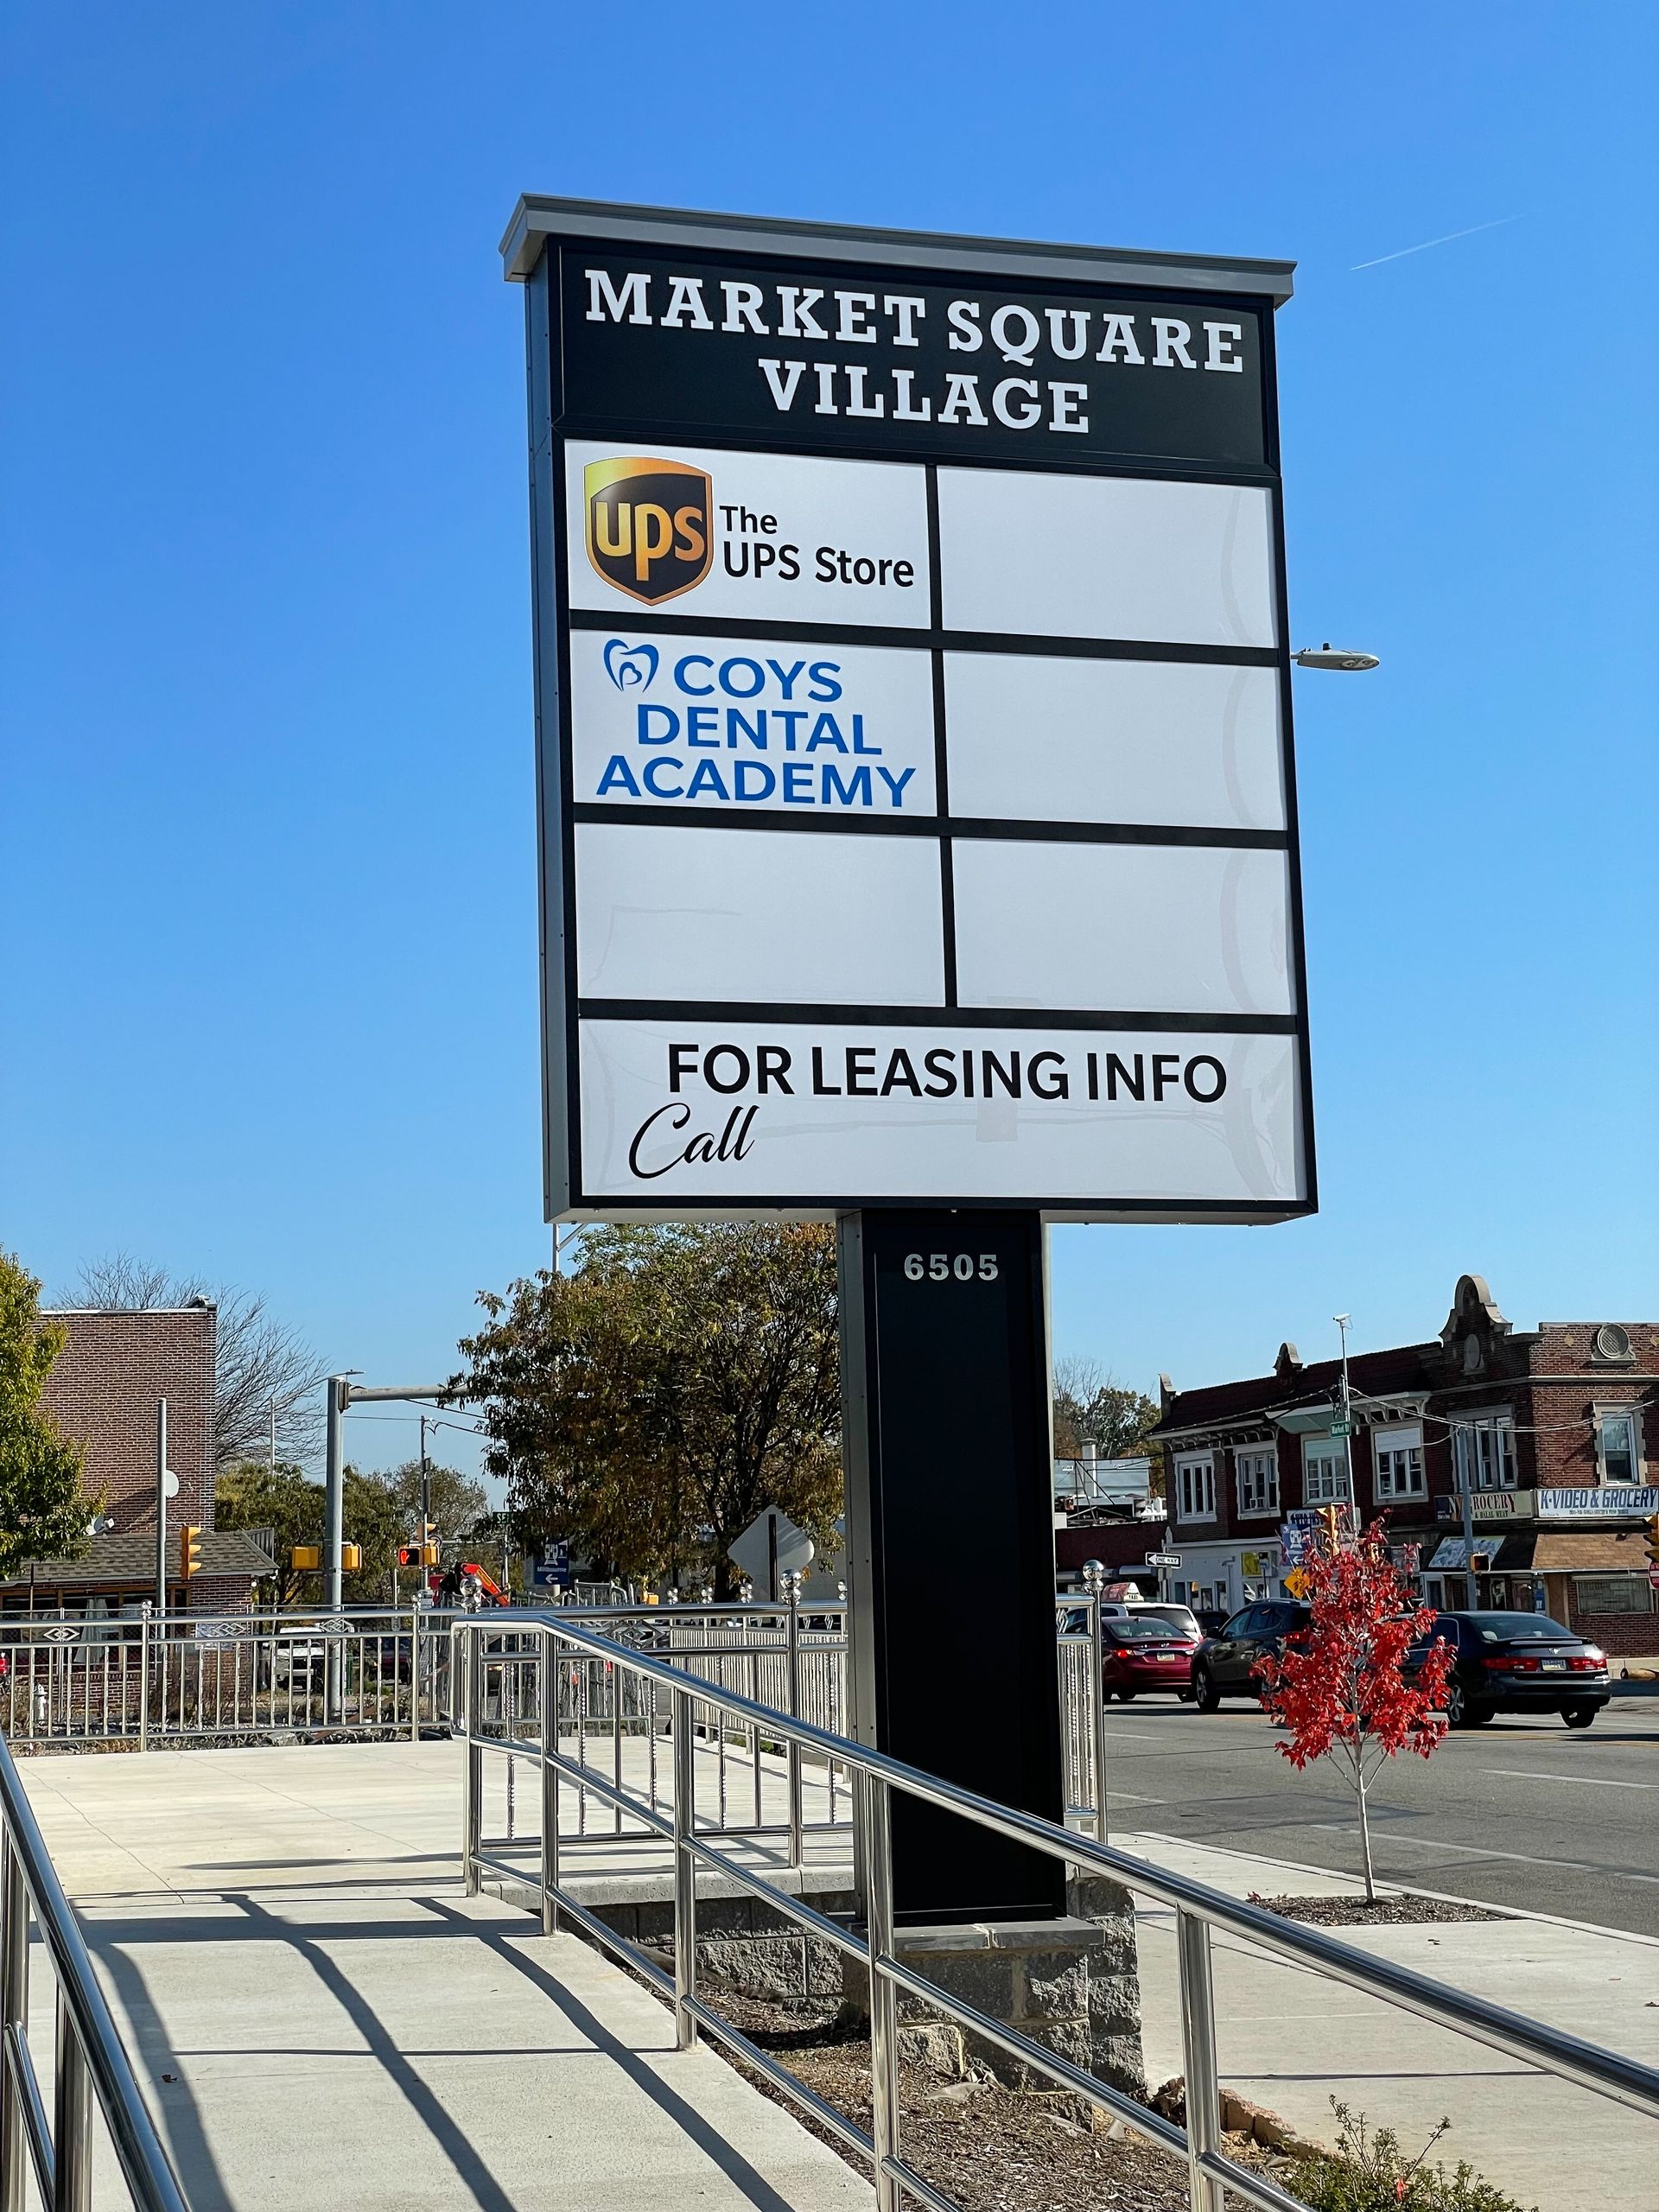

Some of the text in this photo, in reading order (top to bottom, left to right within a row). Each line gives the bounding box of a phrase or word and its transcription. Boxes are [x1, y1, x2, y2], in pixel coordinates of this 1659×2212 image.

[584, 269, 1243, 373] MARKET SQUARE
[758, 358, 1090, 435] VILLAGE
[594, 501, 706, 582] ups
[719, 505, 778, 535] The
[723, 541, 914, 588] UPS Store
[673, 655, 843, 702] COYS
[637, 703, 883, 756] DENTAL
[596, 754, 916, 808] ACADEMY
[668, 1043, 1227, 1103] FOR LEASING INFO
[628, 1103, 760, 1179] Call
[904, 1254, 999, 1281] 6505
[1470, 1494, 1516, 1513] ROCERY
[1541, 1488, 1657, 1509] K-VIDEO & GROCERY
